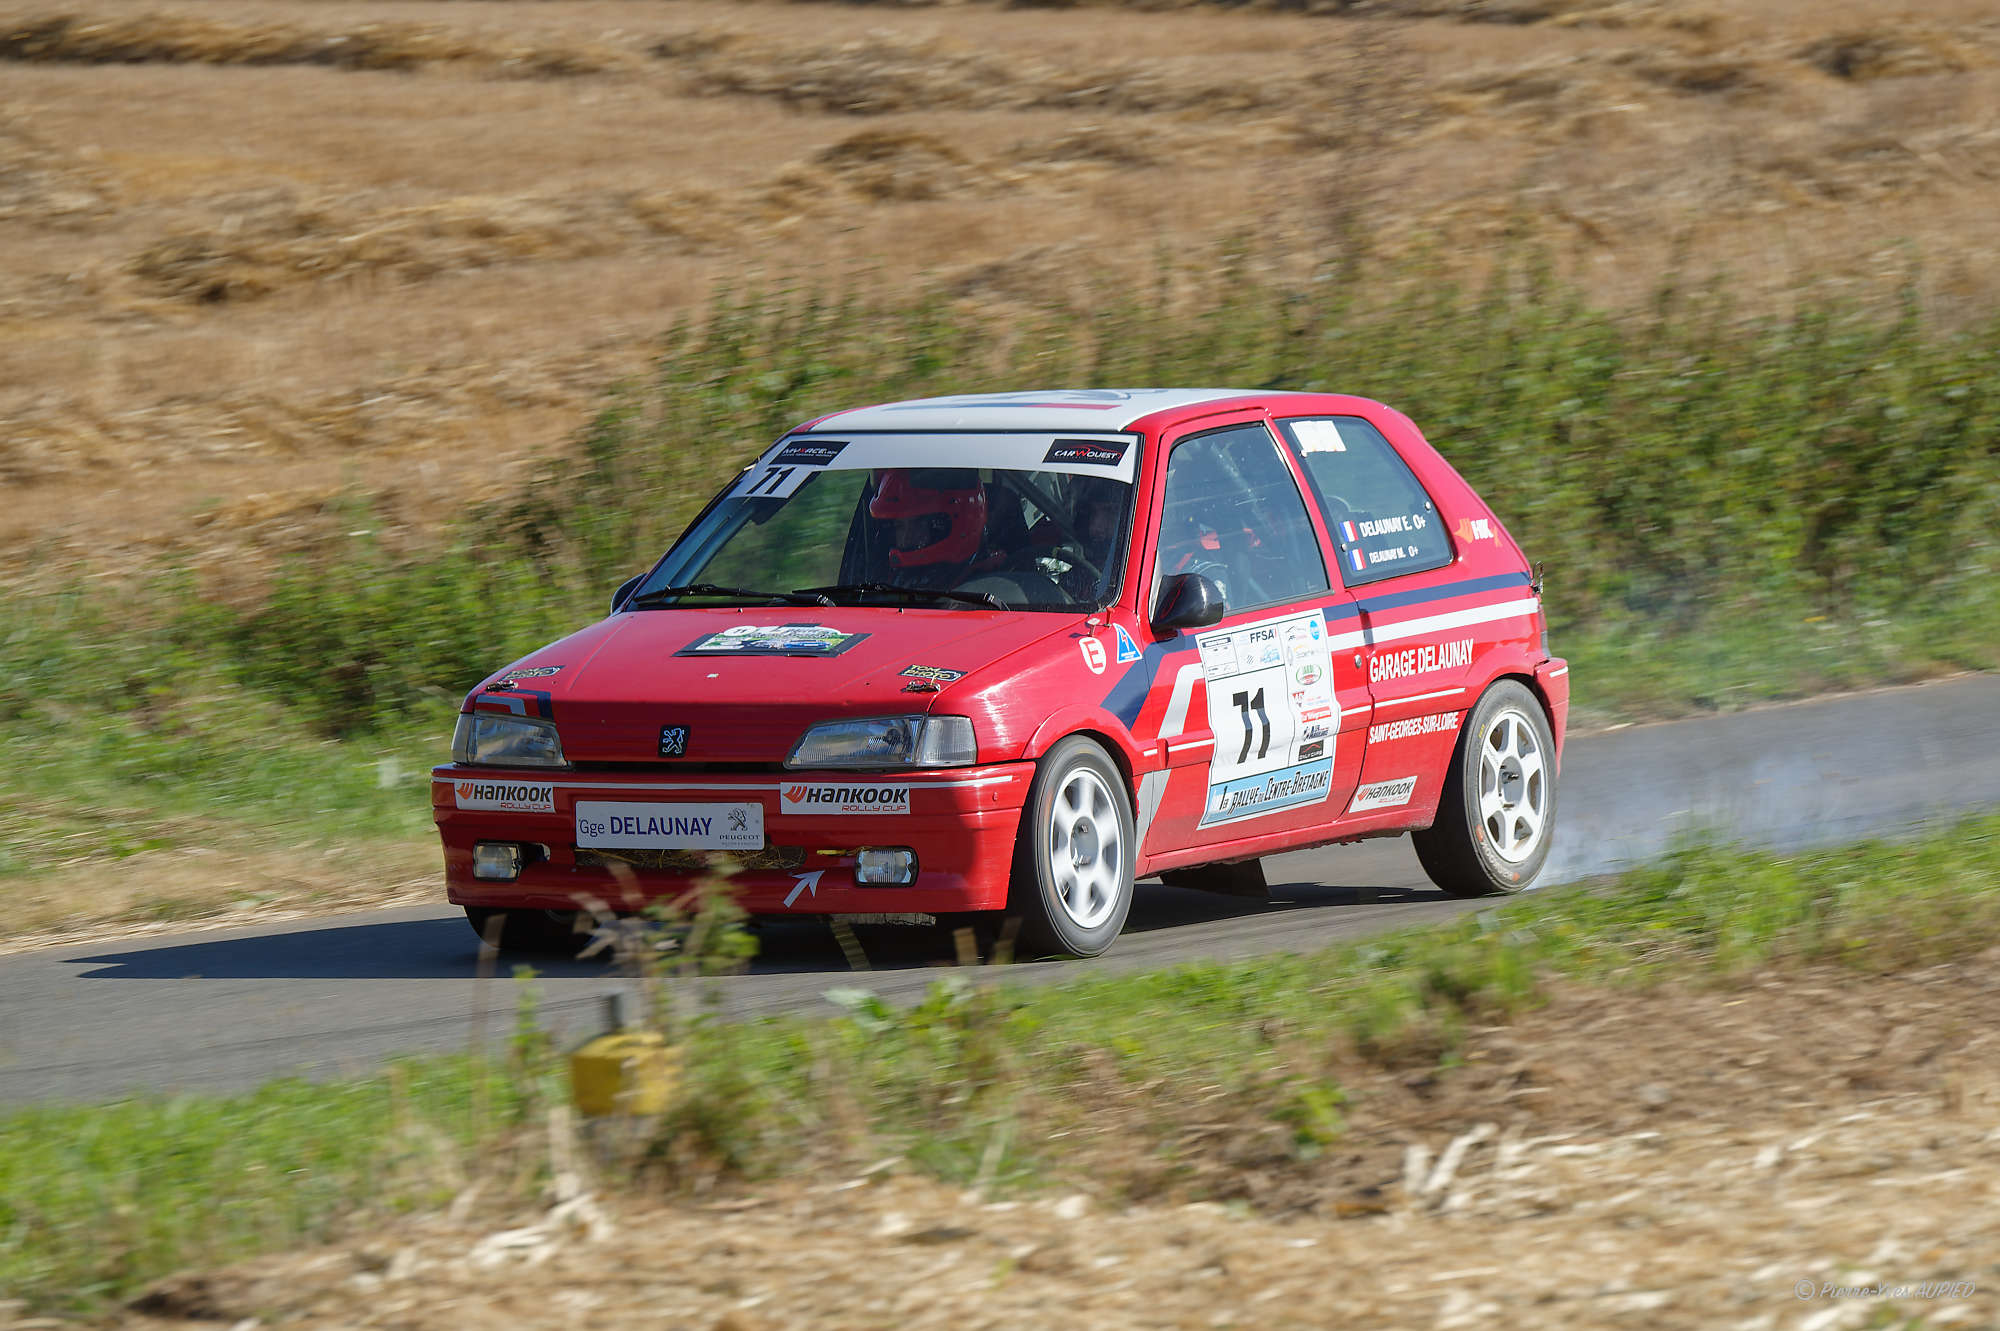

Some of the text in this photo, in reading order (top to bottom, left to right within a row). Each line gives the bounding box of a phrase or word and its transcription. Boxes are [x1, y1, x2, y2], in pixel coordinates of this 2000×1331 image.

[745, 467, 797, 495] 71
[1359, 517, 1401, 538] DELAUNAY
[1250, 629, 1275, 643] FFSA
[1083, 640, 1104, 669] E
[1369, 638, 1474, 683] GARAGE DELAUNAY
[1232, 687, 1271, 765] 71
[1369, 711, 1459, 745] SAINT-GEORGES-SUR-LOIRE
[1227, 787, 1260, 815] RALLYE
[579, 816, 713, 837] Gge DELAUNAY
